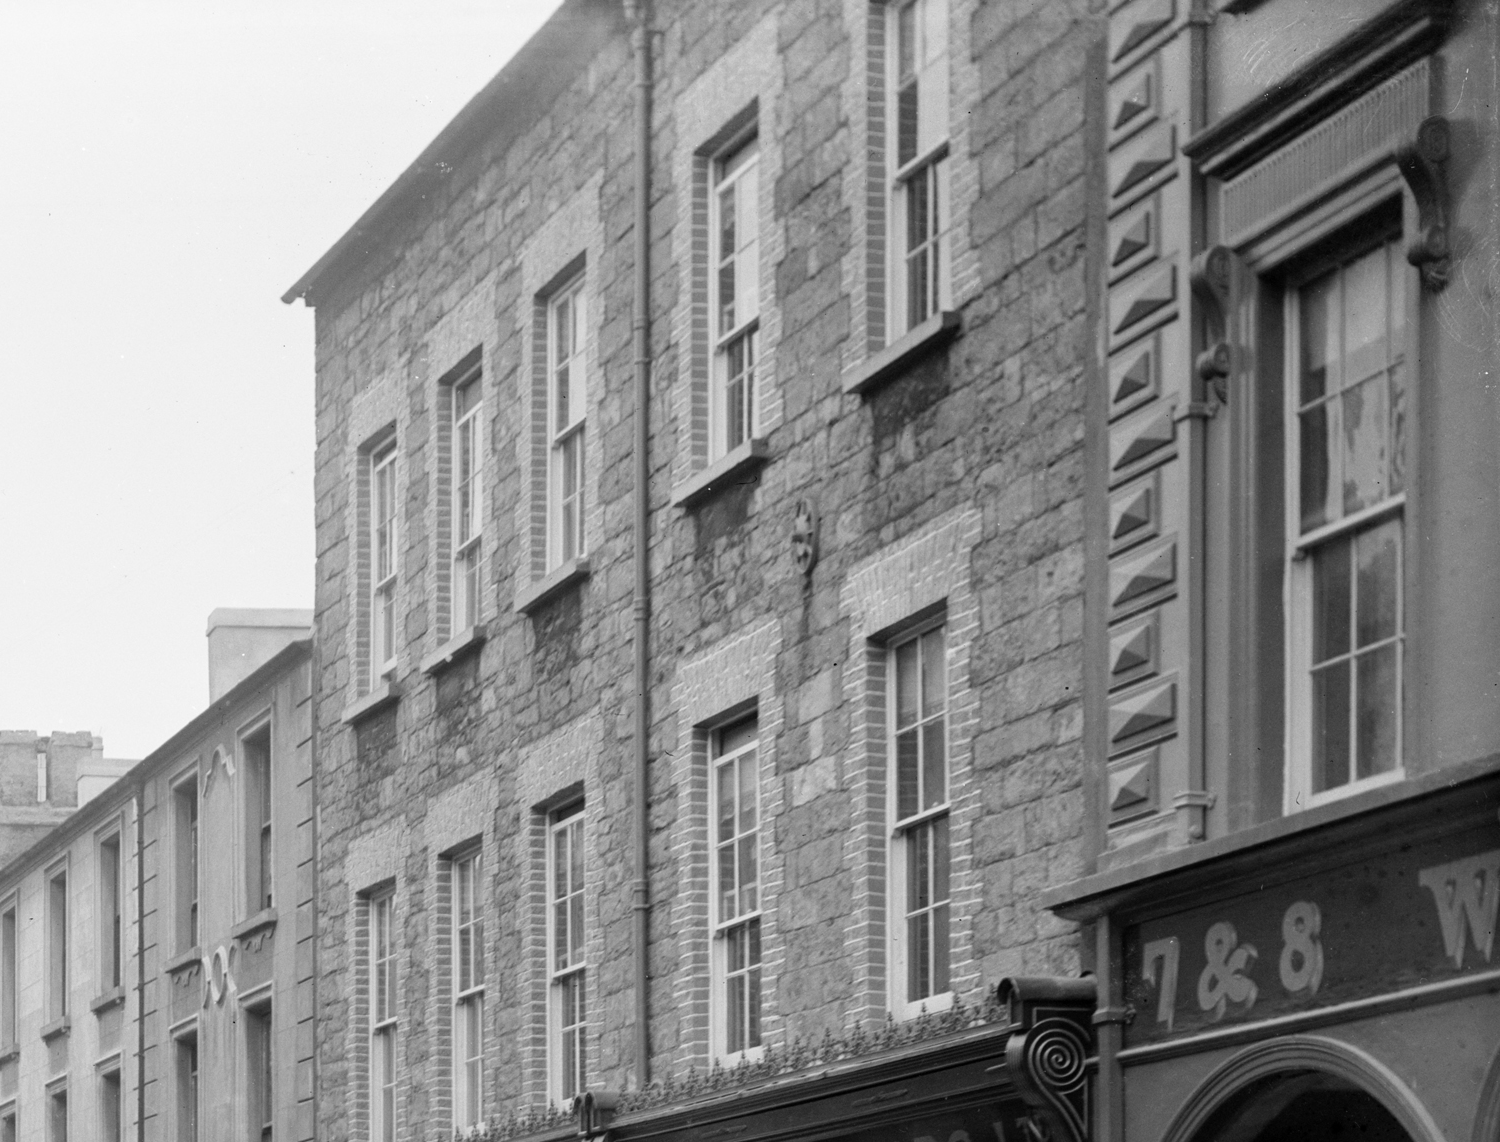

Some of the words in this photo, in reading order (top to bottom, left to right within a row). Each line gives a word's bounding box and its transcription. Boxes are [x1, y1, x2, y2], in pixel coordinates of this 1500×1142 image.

[1142, 935, 1179, 1030] 7
[1197, 920, 1258, 1020] &
[1279, 900, 1323, 995] 8
